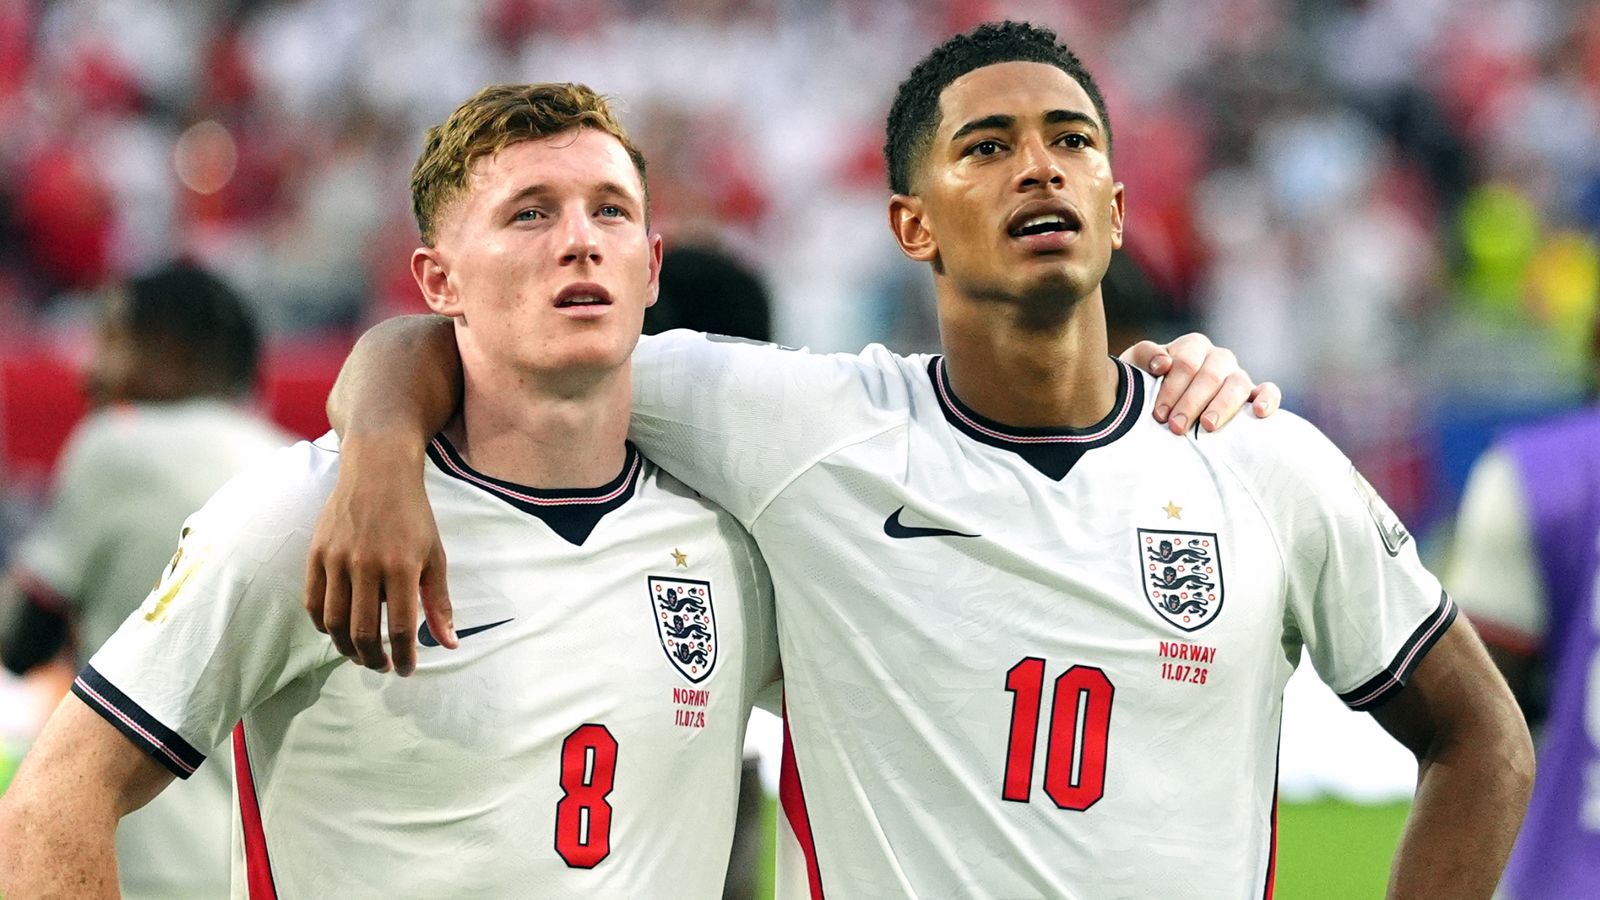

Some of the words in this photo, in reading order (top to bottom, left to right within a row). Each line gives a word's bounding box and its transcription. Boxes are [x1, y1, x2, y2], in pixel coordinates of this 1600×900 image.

[1159, 641, 1216, 664] NORWAY
[1161, 663, 1208, 685] 11.07.26
[673, 688, 710, 707] NORWAY
[675, 710, 705, 728] 11.07.26
[1001, 656, 1115, 812] 10
[554, 723, 619, 870] 8
